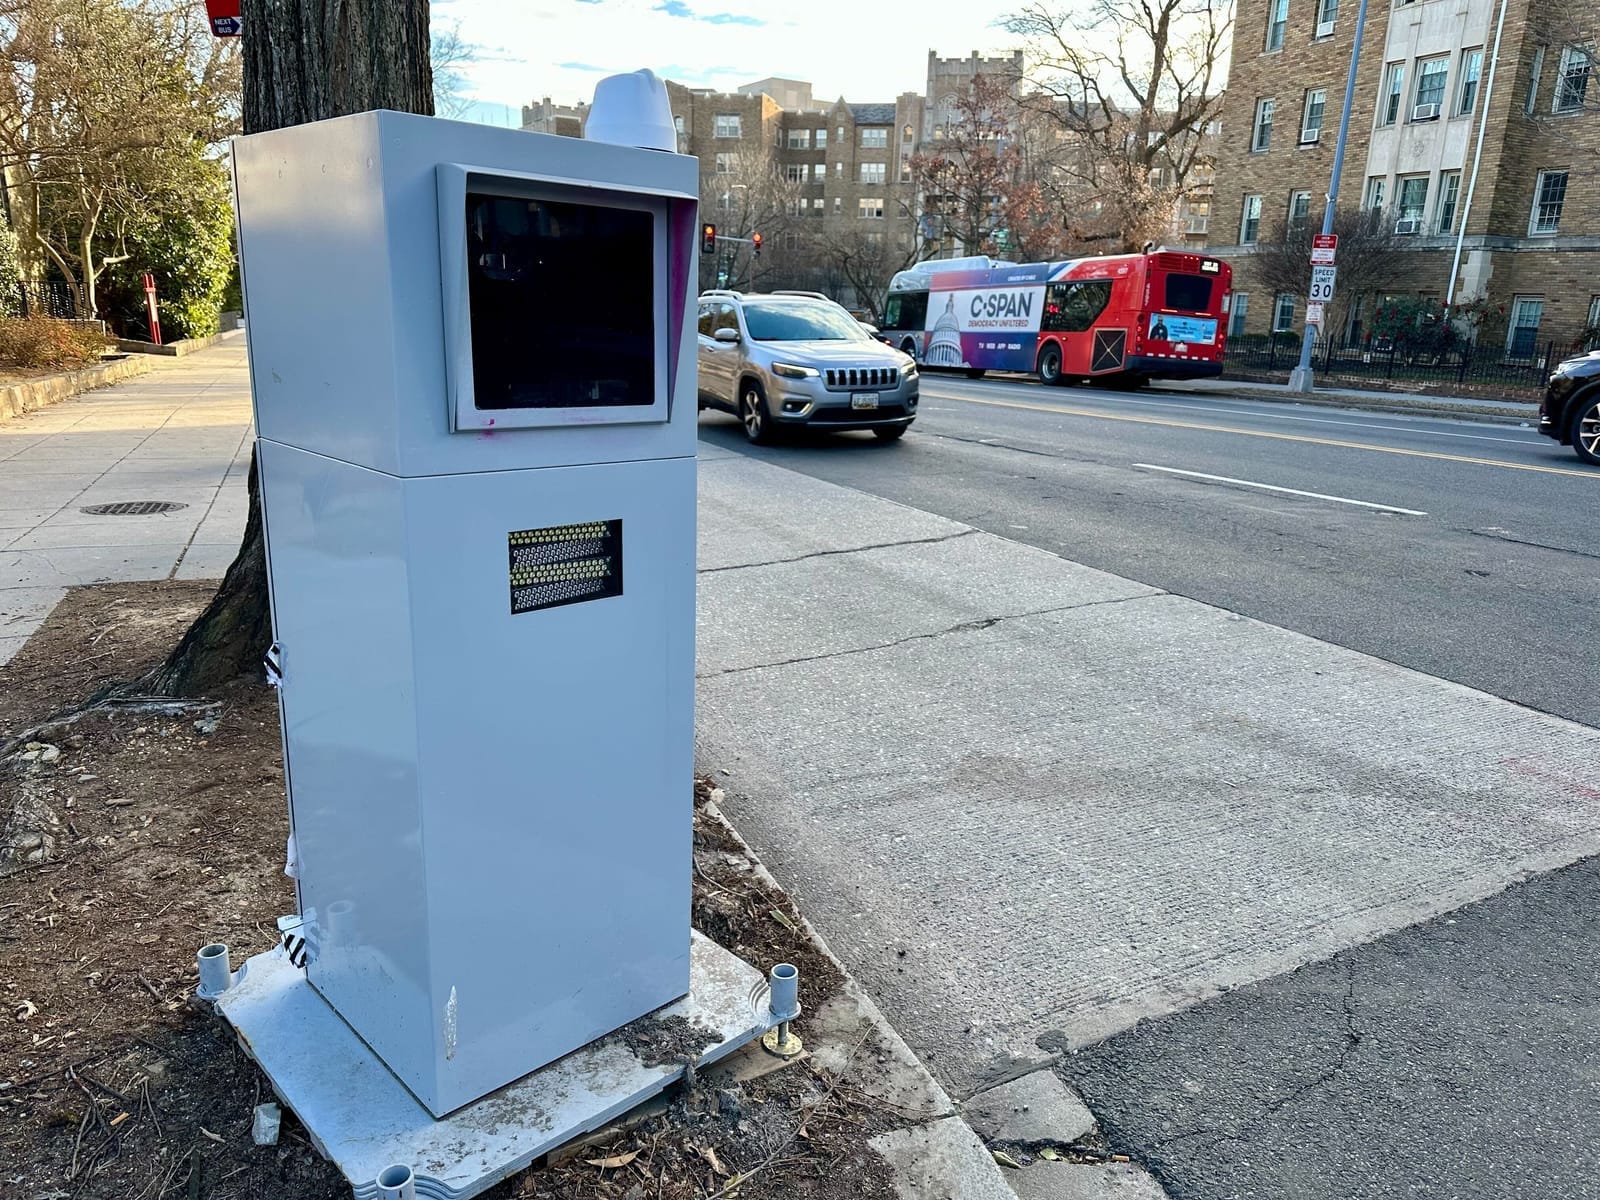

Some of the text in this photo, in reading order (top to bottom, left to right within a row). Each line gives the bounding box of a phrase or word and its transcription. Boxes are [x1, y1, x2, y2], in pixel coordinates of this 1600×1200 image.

[1311, 284, 1331, 298] 30
[968, 319, 1029, 328] DEMOCRACY UNFILTERED
